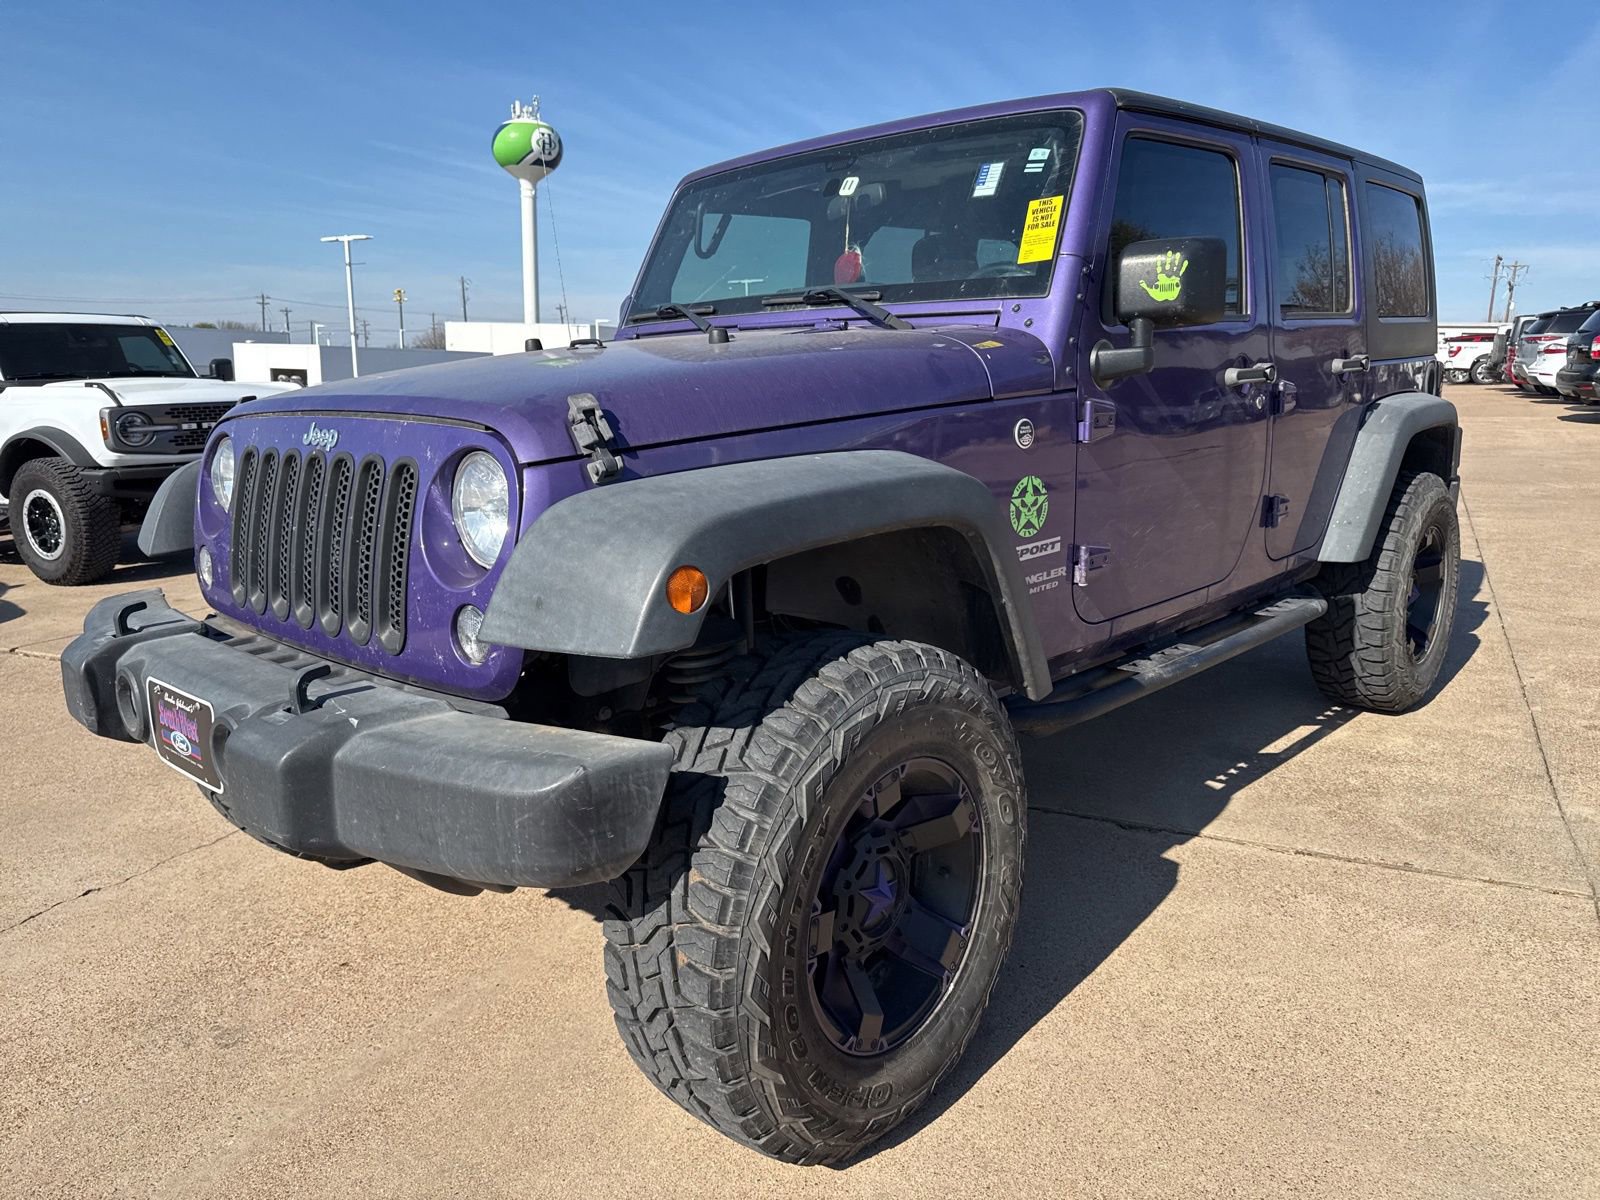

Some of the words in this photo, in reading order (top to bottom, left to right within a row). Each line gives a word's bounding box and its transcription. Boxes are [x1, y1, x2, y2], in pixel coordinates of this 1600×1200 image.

[1038, 198, 1053, 206] THIS
[1031, 205, 1057, 216] VEHICLE
[1032, 215, 1039, 223] IS
[1040, 213, 1054, 222] NOT
[1027, 222, 1040, 231] FOR
[1040, 220, 1056, 229] SALE
[303, 422, 338, 451] Jeep
[1016, 541, 1059, 558] PORT
[1025, 566, 1067, 585] NGLER
[1029, 581, 1059, 595] MITED
[782, 804, 832, 1063] COUNTRY
[807, 1068, 893, 1110] OPEN
